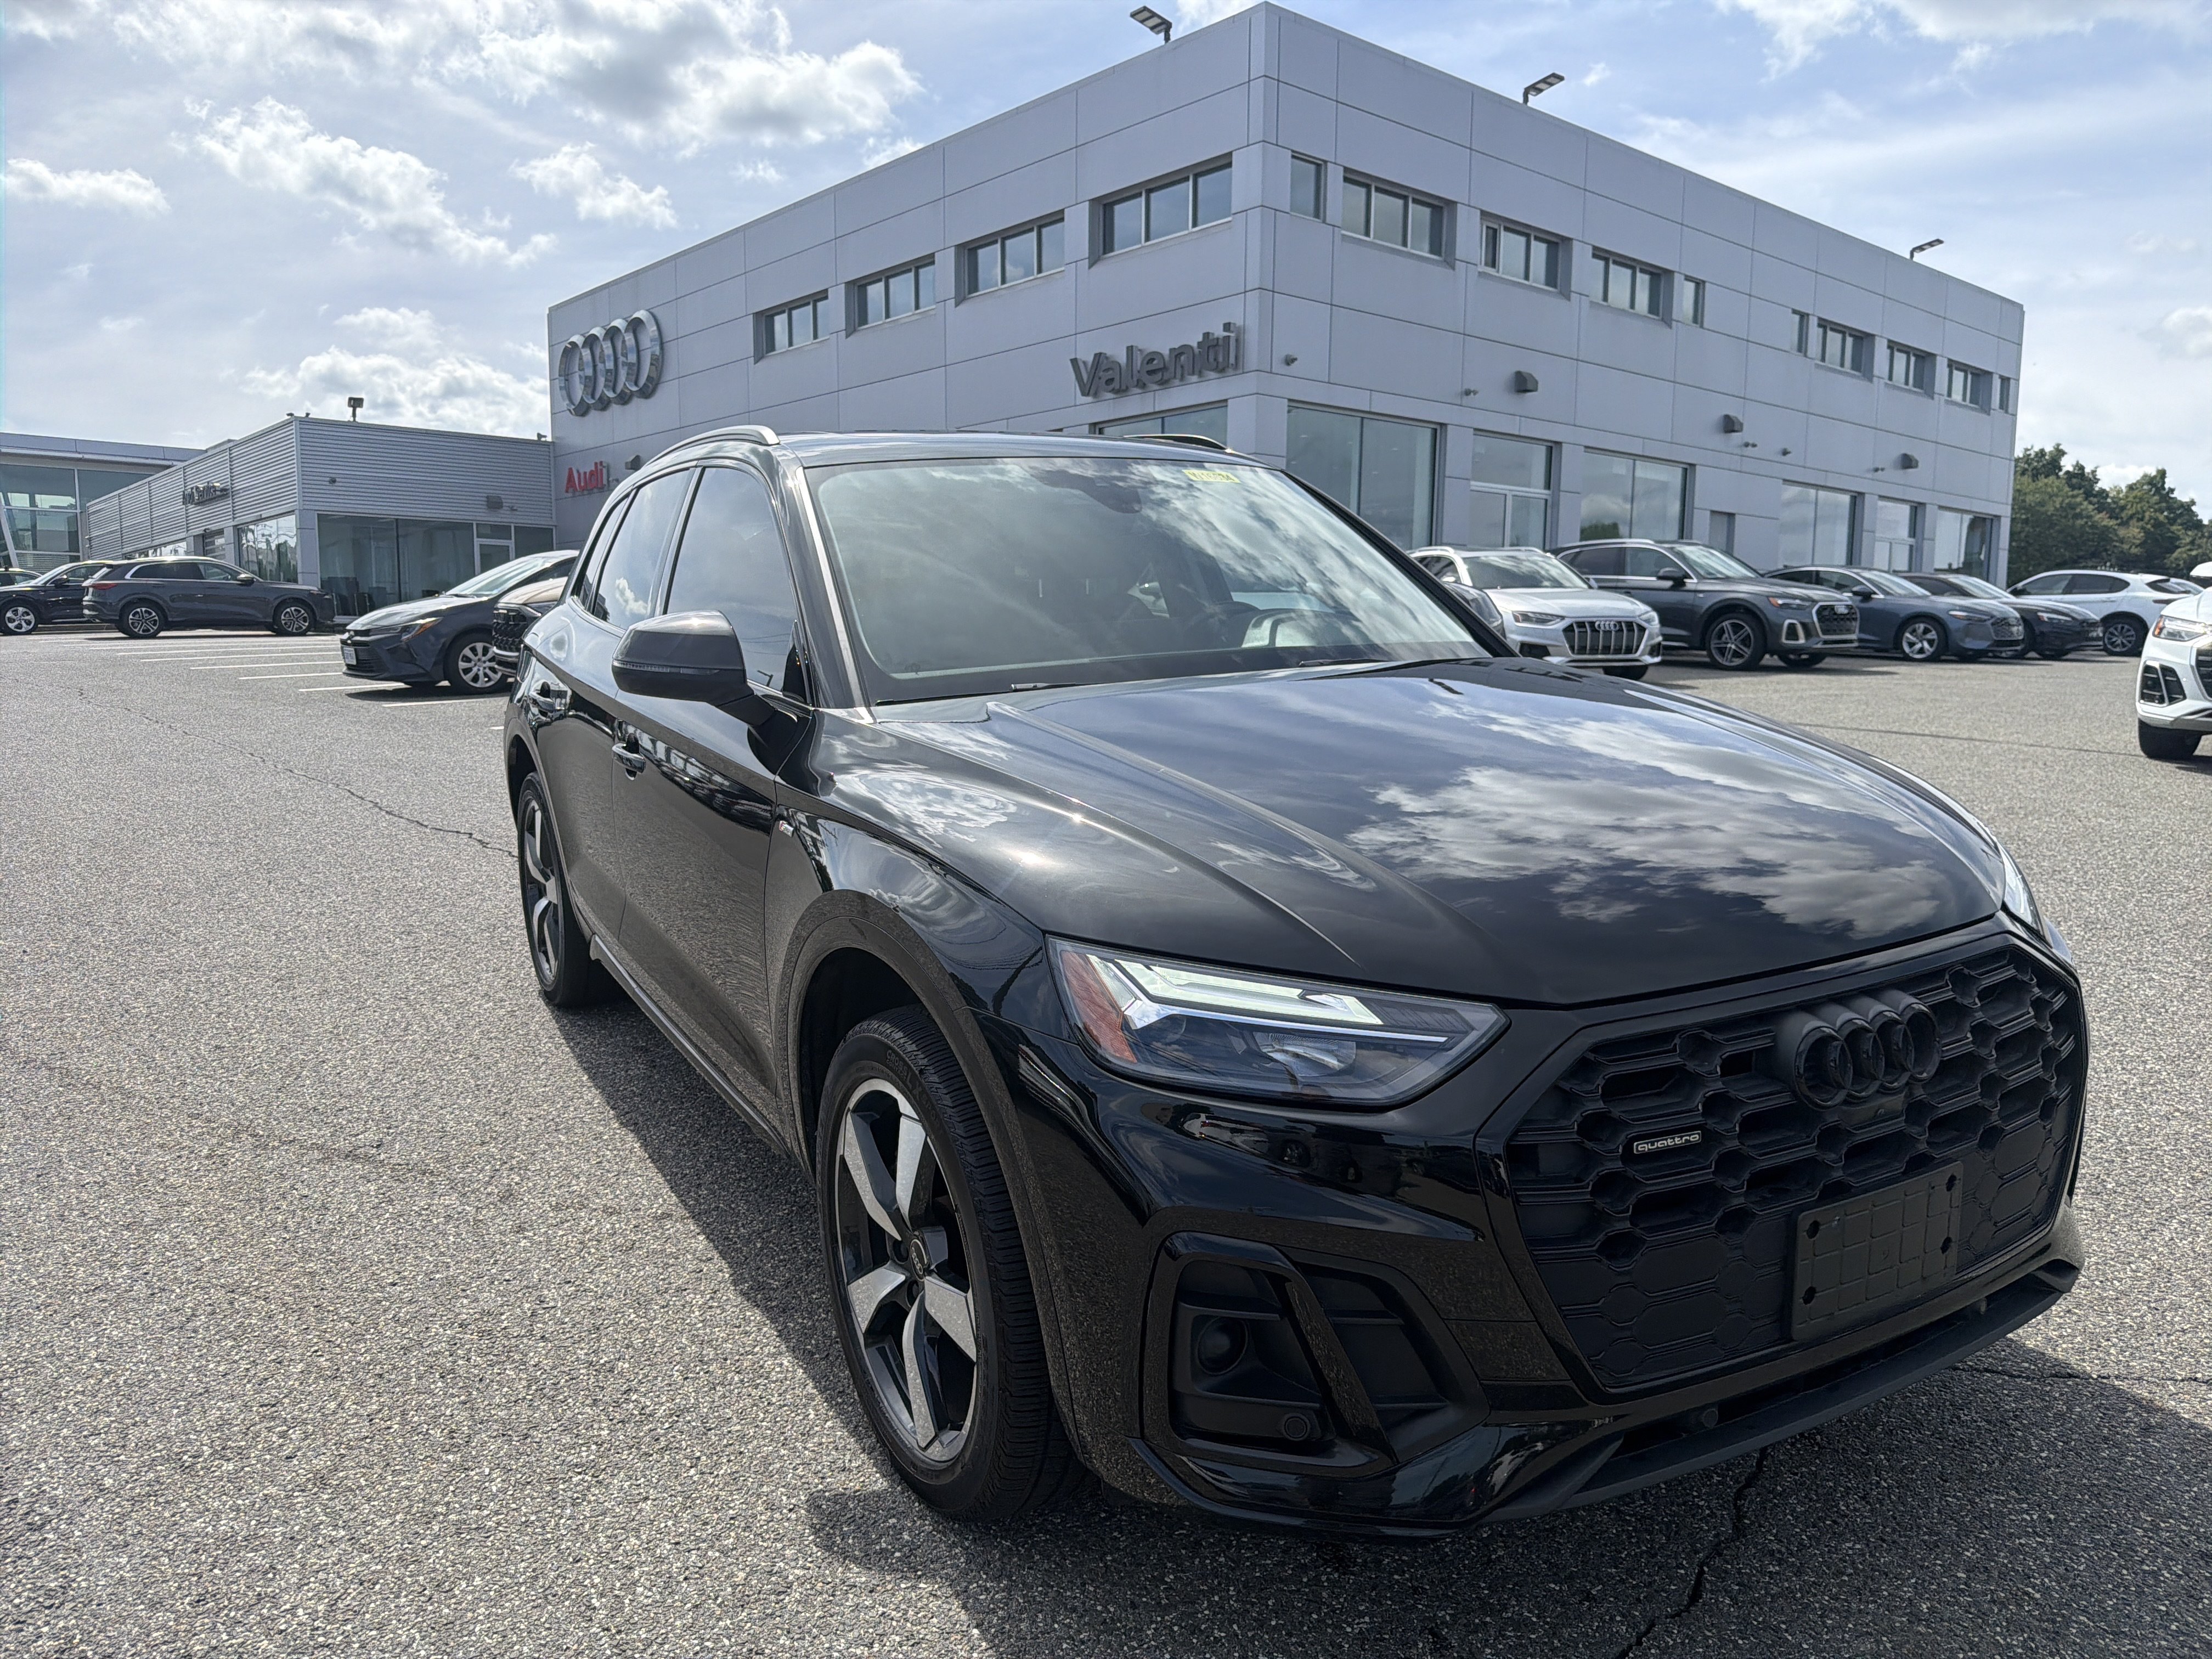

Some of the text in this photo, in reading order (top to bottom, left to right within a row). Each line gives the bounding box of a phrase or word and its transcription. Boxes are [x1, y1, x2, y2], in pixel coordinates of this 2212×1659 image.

[1069, 321, 1239, 397] Valenti
[565, 460, 605, 493] Audi
[1638, 1134, 1699, 1152] quattro
